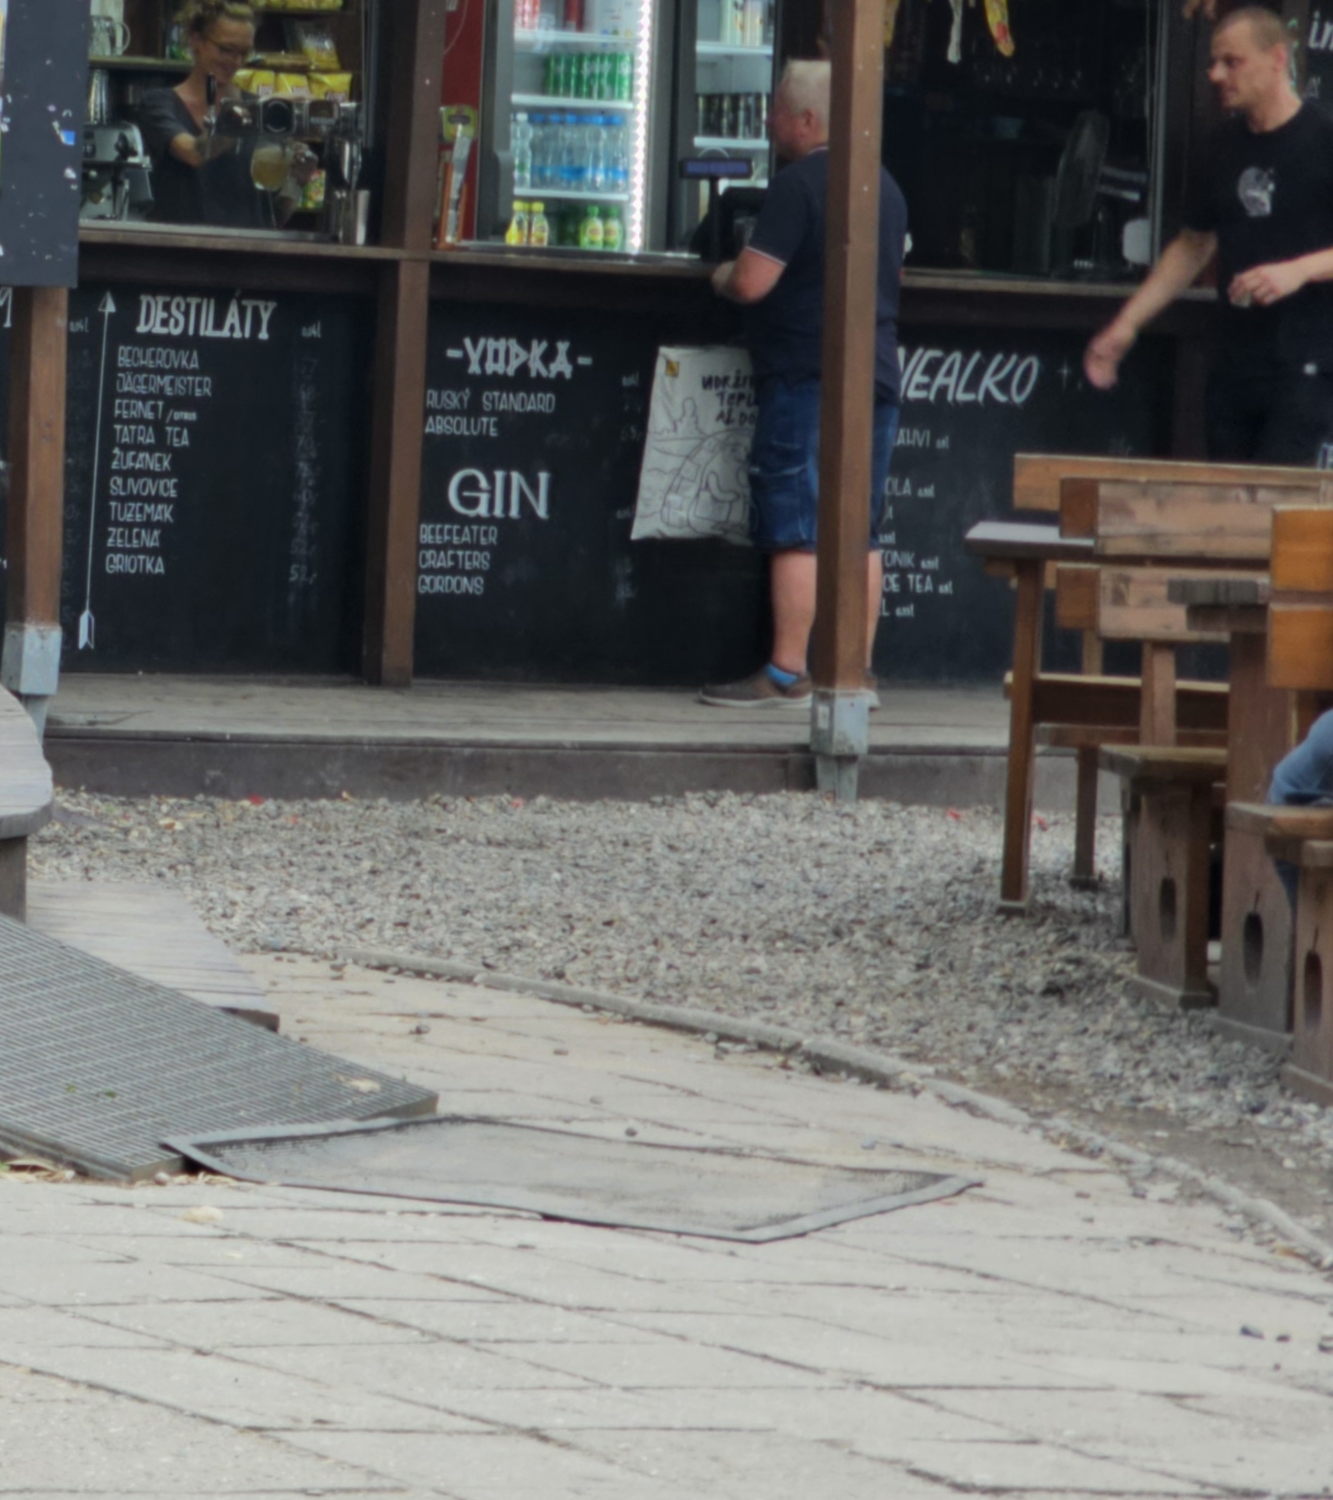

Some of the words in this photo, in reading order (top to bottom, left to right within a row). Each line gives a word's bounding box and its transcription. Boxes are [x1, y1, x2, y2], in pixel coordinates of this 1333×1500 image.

[136, 289, 277, 340] DESTILÁTY
[117, 345, 200, 370] BECHEROVKA
[116, 371, 213, 397] JÄGERMEISTER
[114, 399, 165, 420] FERNET
[425, 388, 471, 413] RUSKÝ
[482, 391, 556, 414] STANDARD
[113, 424, 156, 445] TATRA
[165, 426, 190, 447] TEA
[424, 416, 499, 438] ABSOLUTE
[111, 447, 172, 472] ŽUFÁNEK
[109, 476, 179, 498] SLIVOVICE
[447, 467, 552, 521] GIN
[109, 501, 175, 523] TUZEMÁK
[106, 527, 162, 548] ZELENÁ
[418, 523, 499, 547] BEEFEATER
[105, 553, 166, 575] GRIOTKA
[418, 549, 491, 572] CRAFTERS
[881, 550, 916, 569] TONIK
[417, 574, 485, 596] GORDONS
[907, 573, 934, 594] TEA
